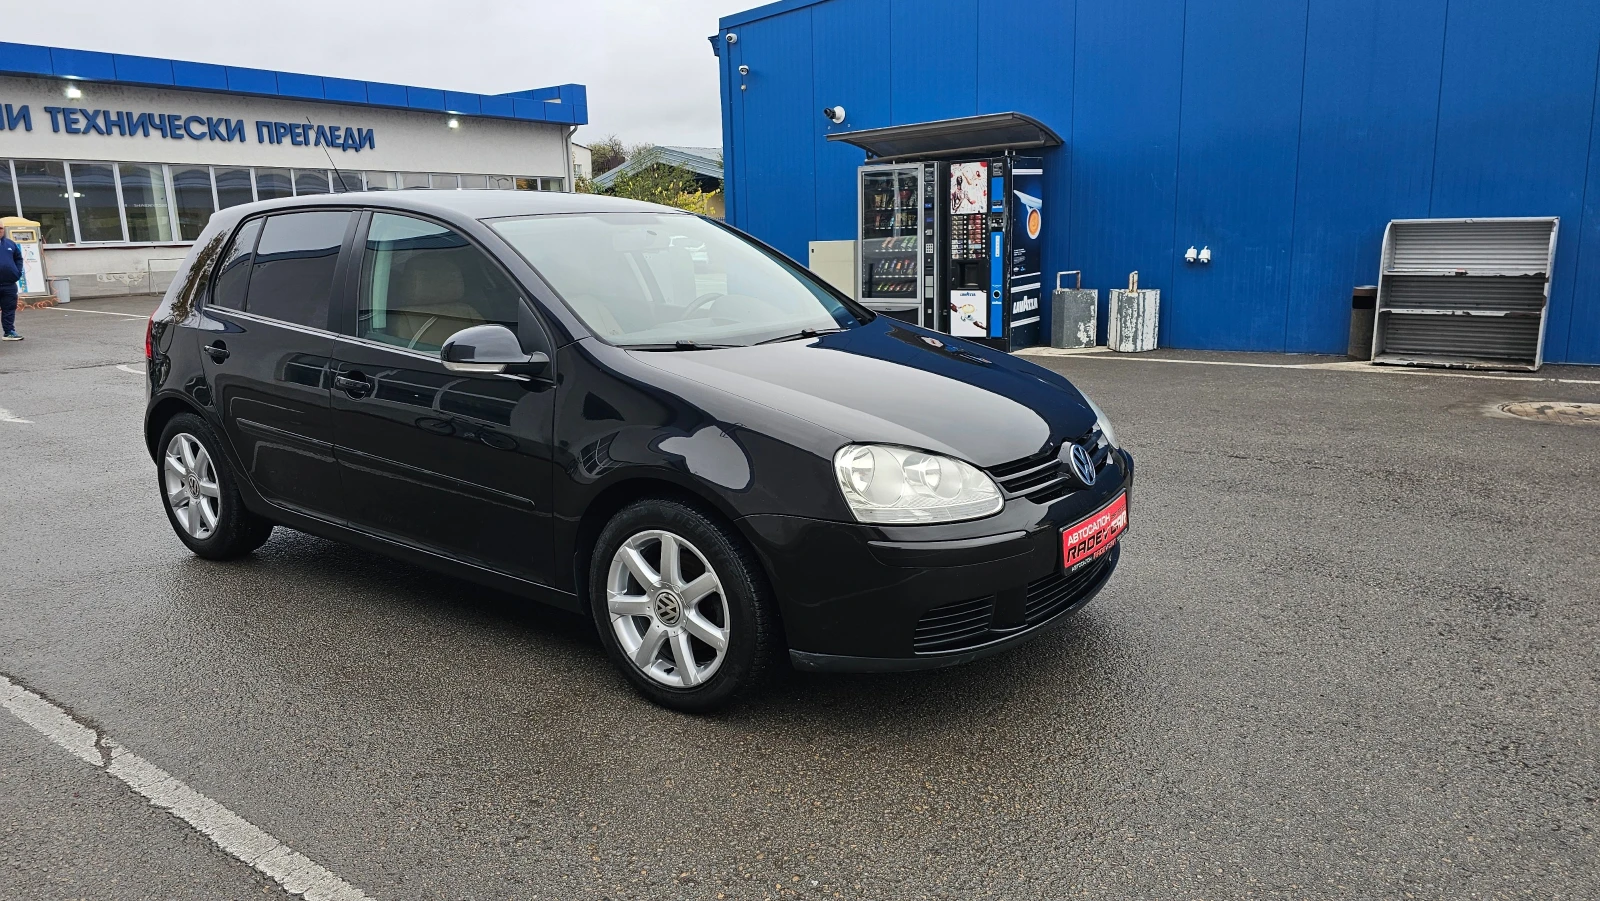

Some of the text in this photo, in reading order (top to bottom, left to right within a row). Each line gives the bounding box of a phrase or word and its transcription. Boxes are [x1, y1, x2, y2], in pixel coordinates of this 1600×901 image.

[0, 103, 376, 152] И ТЕХНИЧЕСКИ ПРЕГЛЕДИ
[1012, 295, 1038, 315] LAVAZZA
[1067, 512, 1111, 547] АВТОСАЛОН
